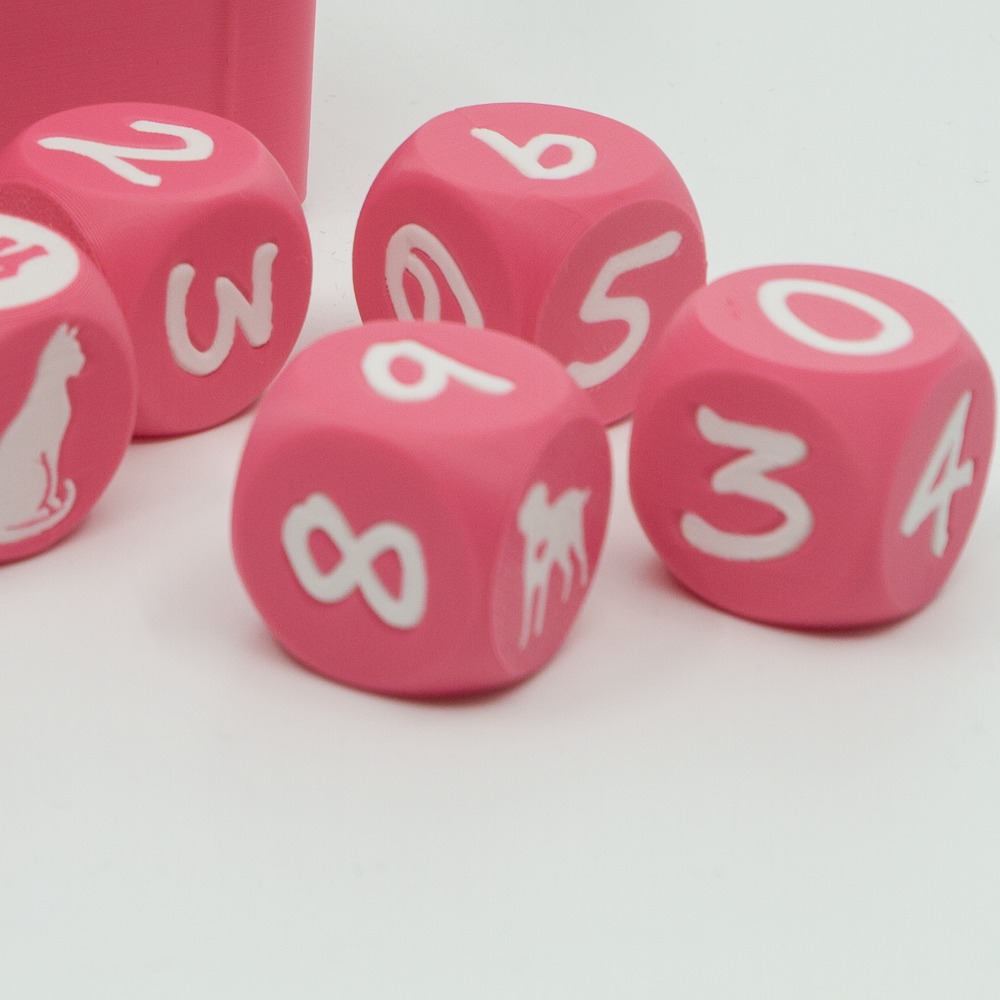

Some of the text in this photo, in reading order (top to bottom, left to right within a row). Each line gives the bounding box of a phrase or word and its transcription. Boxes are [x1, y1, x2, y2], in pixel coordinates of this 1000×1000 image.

[565, 229, 683, 390] 5
[757, 278, 915, 356] 0
[680, 405, 814, 562] 3
[899, 390, 974, 558] 4
[281, 492, 428, 630] 8
